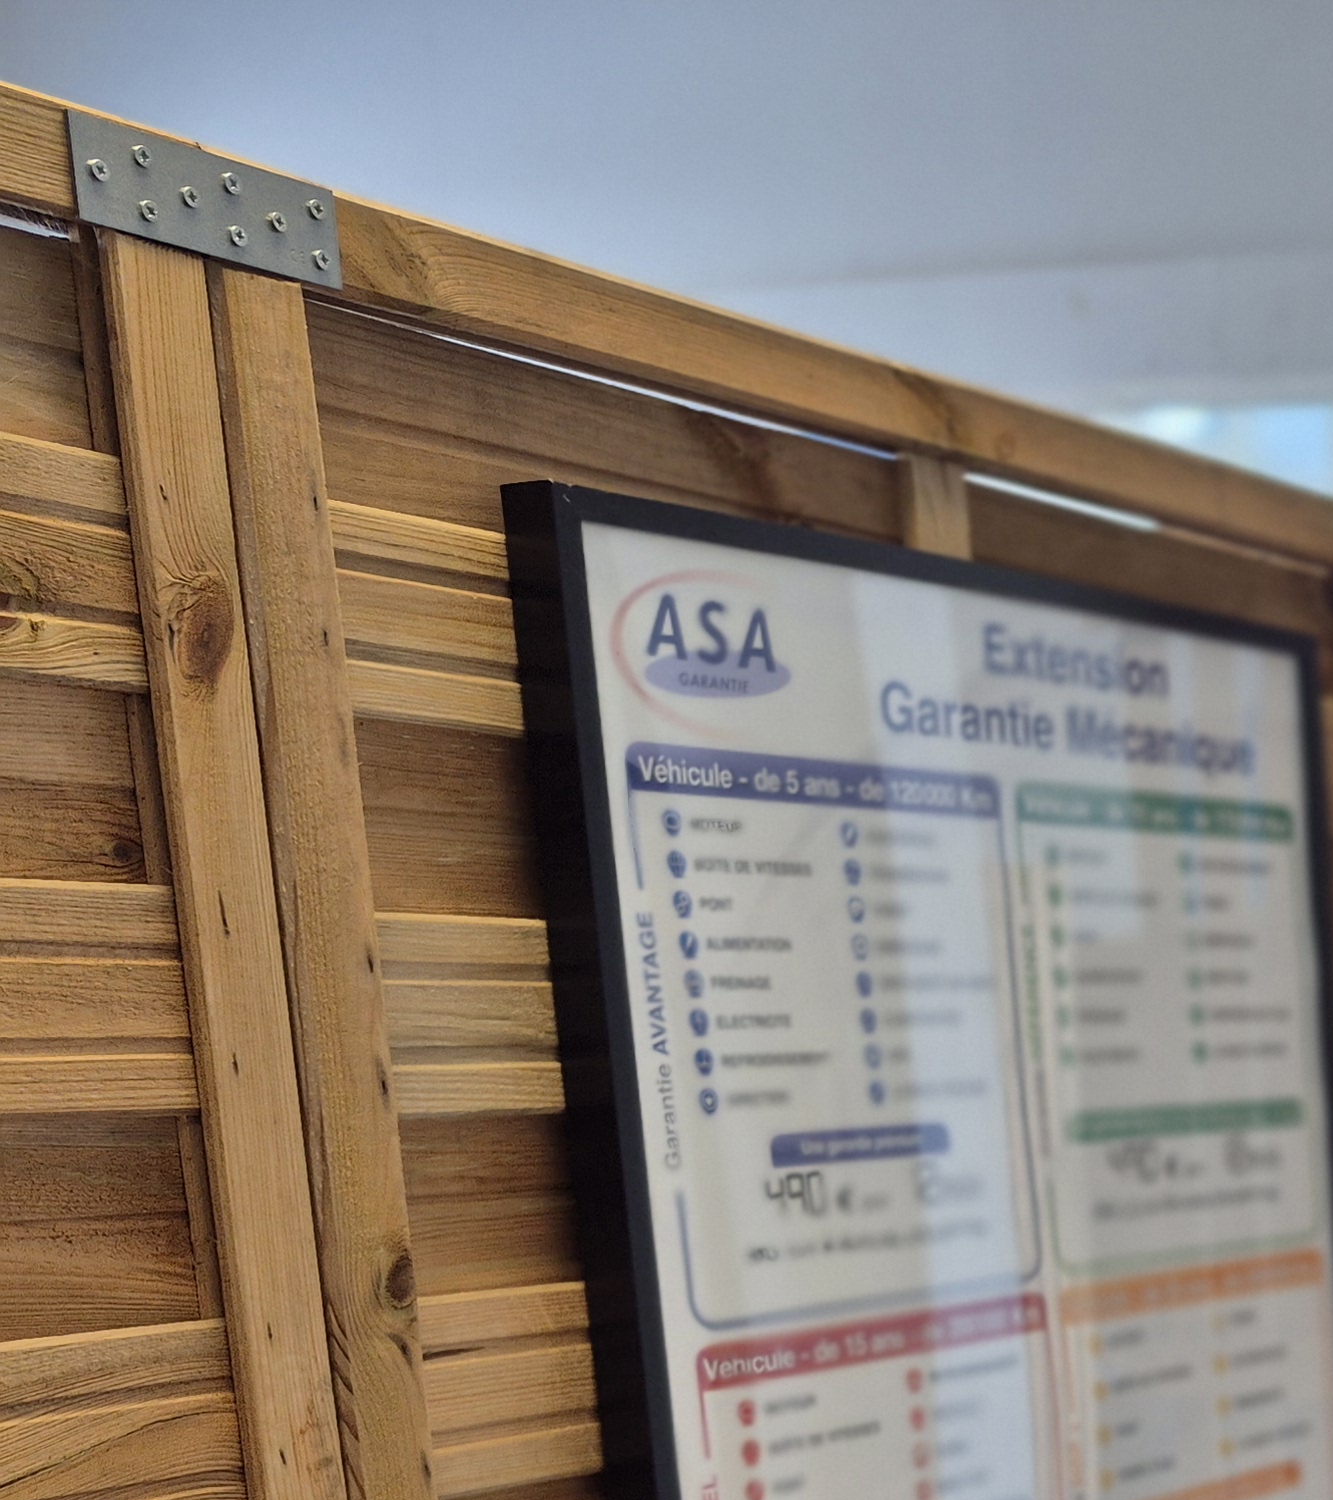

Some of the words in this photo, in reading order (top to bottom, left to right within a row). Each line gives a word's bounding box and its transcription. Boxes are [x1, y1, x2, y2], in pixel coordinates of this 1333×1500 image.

[645, 593, 776, 673] ASA
[982, 622, 1170, 696] Extension
[678, 672, 750, 694] GARANTIE
[881, 681, 1055, 751] Garantie
[1066, 704, 1257, 778] Mécanique
[638, 755, 733, 789] Véhicule
[754, 768, 781, 792] de
[786, 770, 799, 793] 5
[804, 777, 841, 798] ans
[637, 912, 672, 1056] AVANTAGE
[656, 1062, 683, 1170] Garantie
